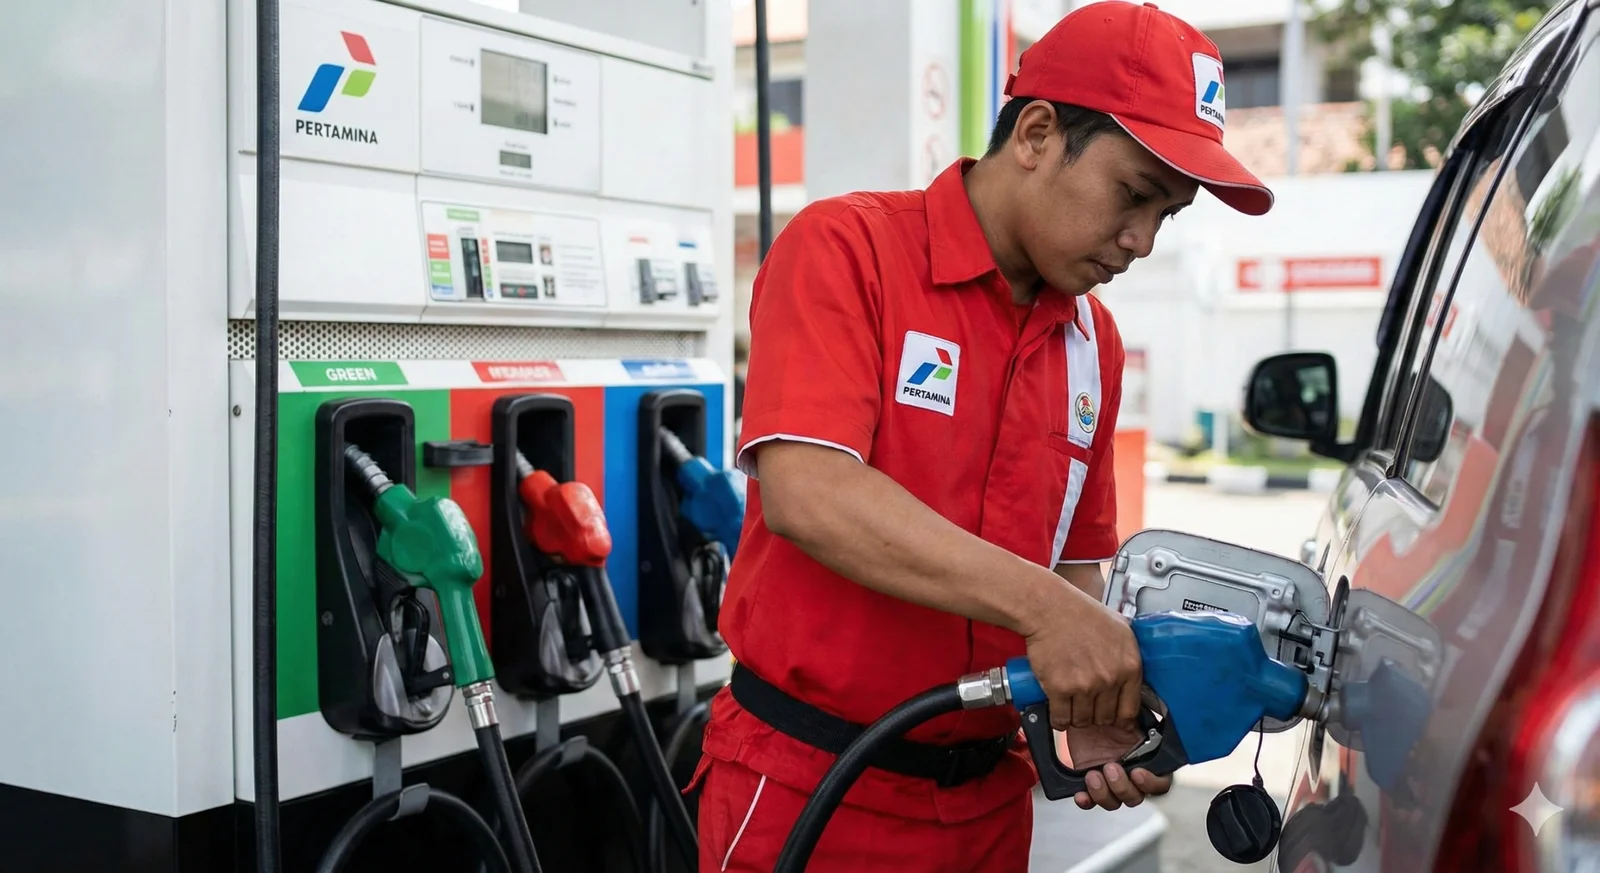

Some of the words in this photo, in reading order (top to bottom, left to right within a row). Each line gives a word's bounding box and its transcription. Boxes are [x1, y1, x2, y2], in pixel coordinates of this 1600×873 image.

[296, 119, 378, 144] PERTAMINA
[325, 367, 378, 381] GREEN
[903, 386, 951, 406] PERTAMINA
